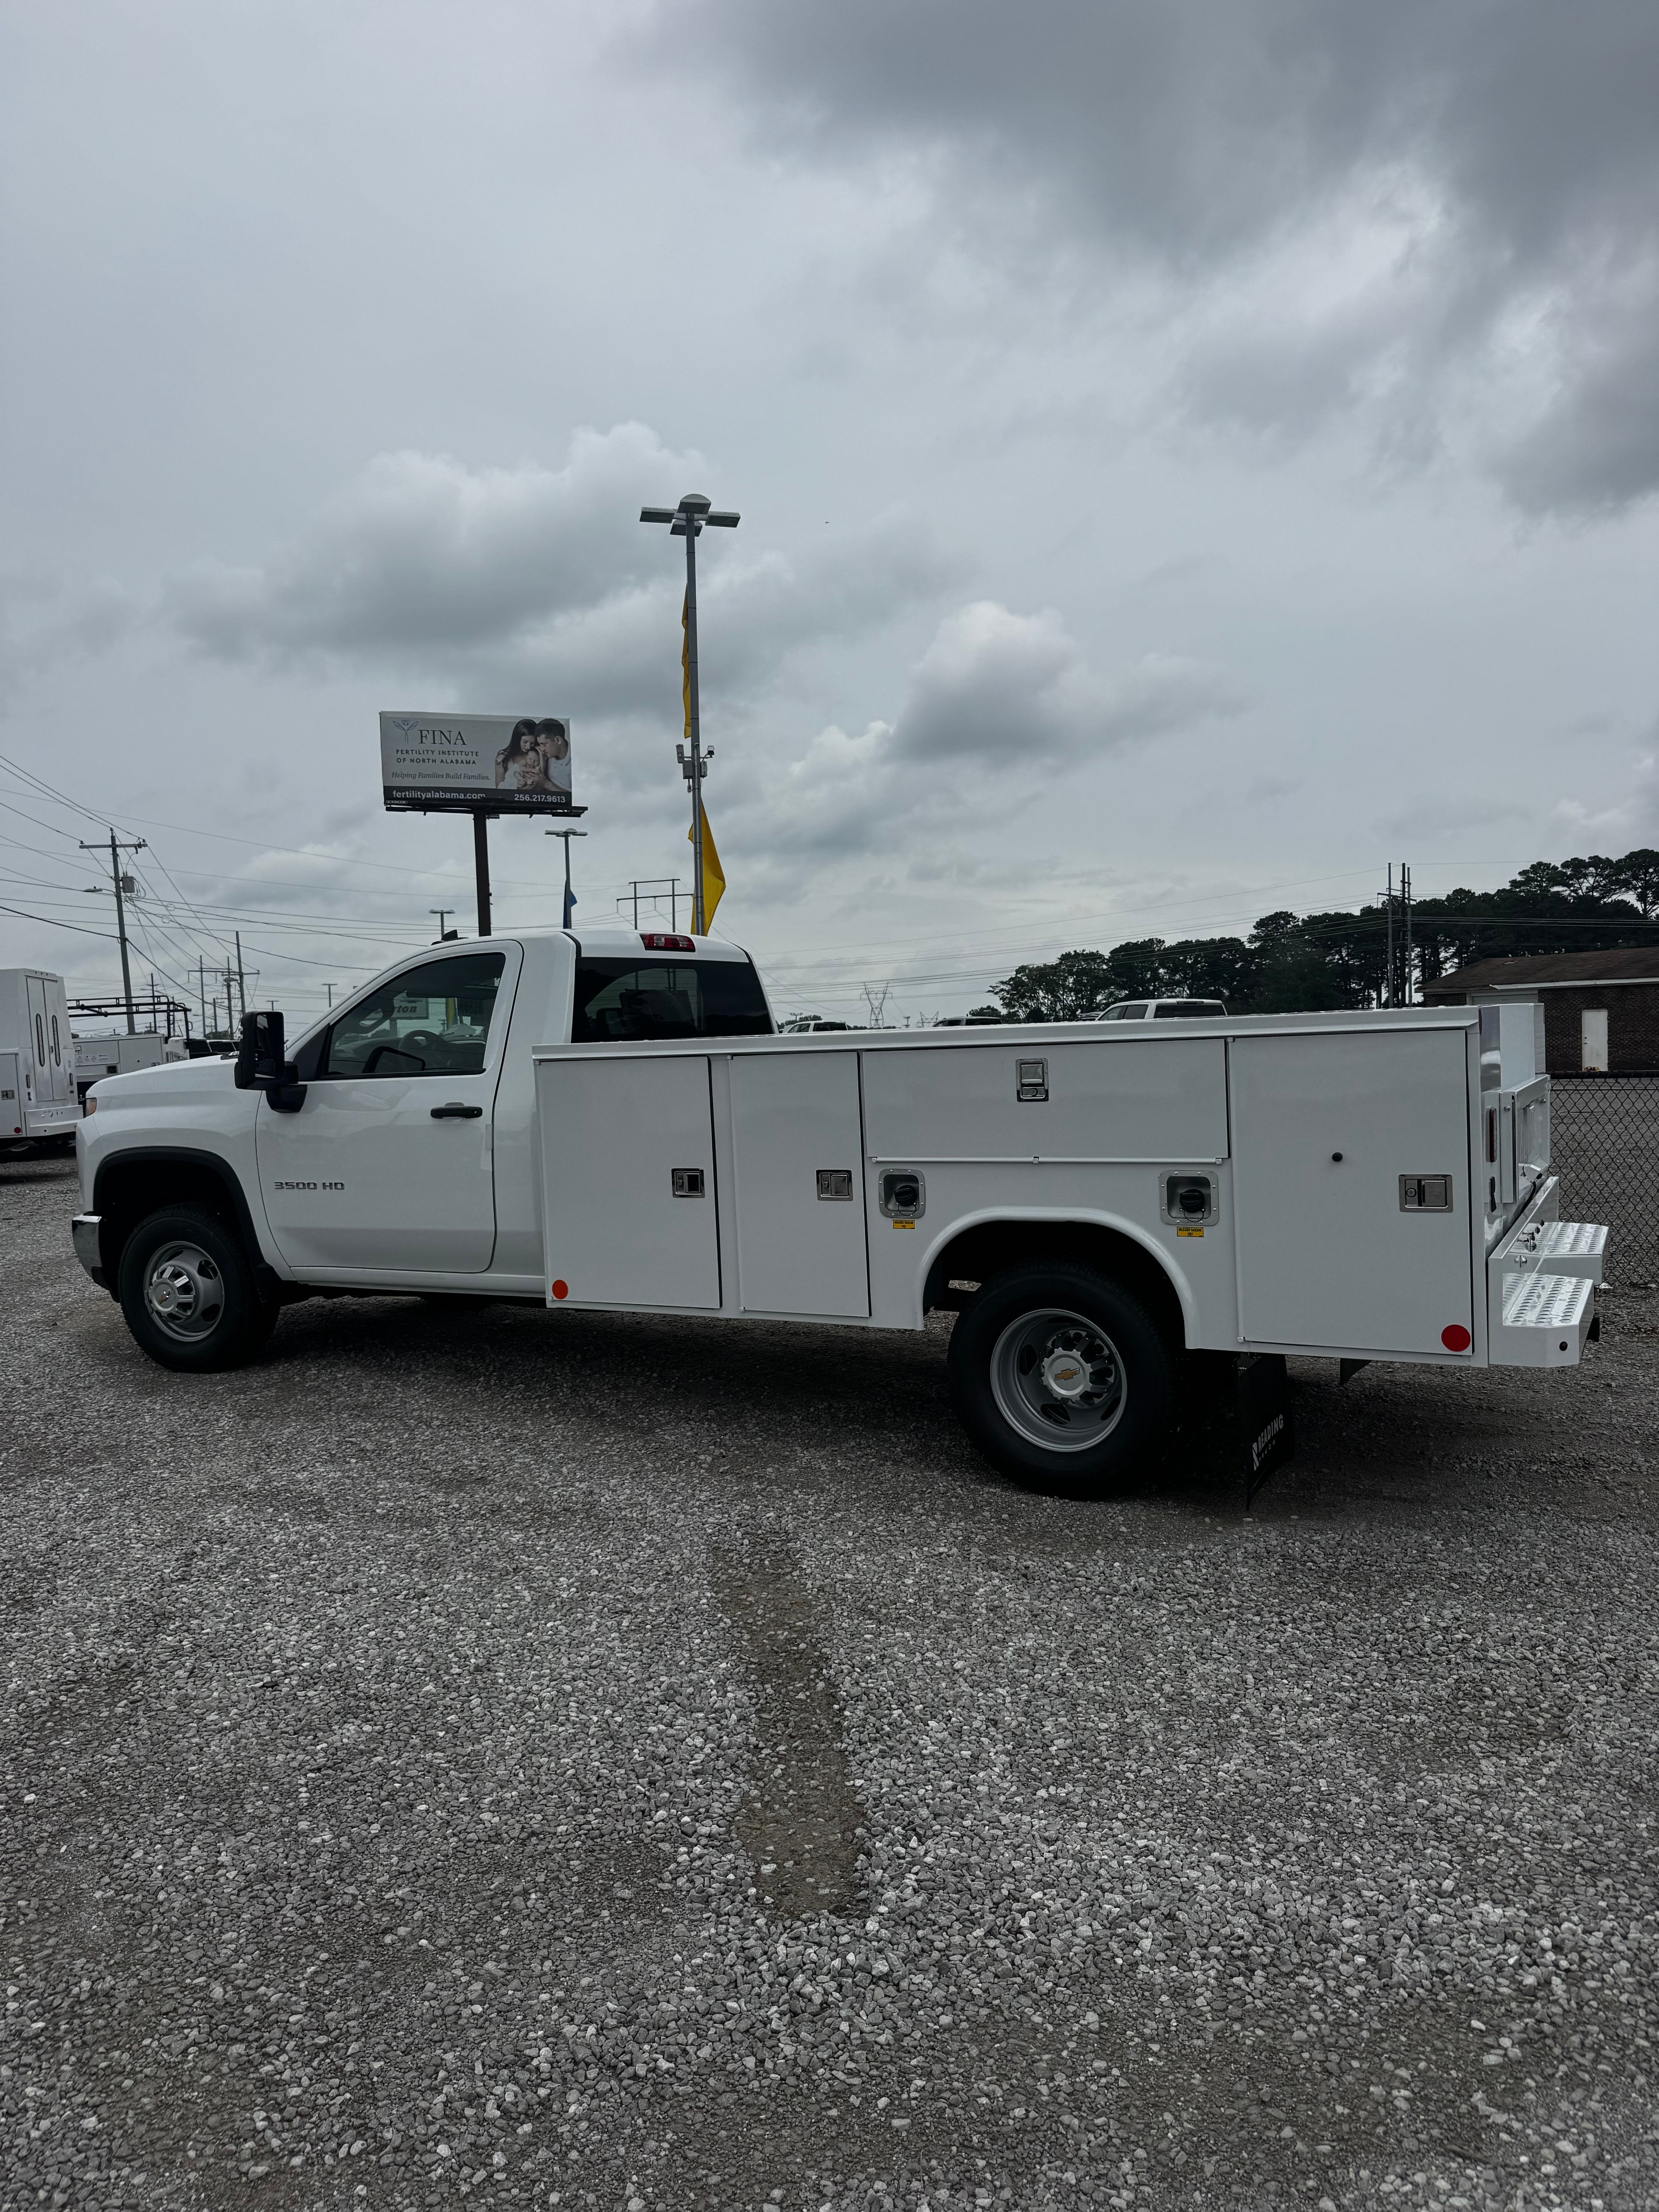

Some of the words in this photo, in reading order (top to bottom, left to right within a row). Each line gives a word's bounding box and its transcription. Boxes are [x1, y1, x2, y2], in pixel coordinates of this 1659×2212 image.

[418, 730, 467, 745] FINA
[393, 790, 486, 800] fertilityalabama.com
[514, 794, 566, 803] 256.217.9613
[274, 1182, 318, 1190] 3500
[322, 1182, 345, 1190] HD
[1258, 1413, 1284, 1453] READING
